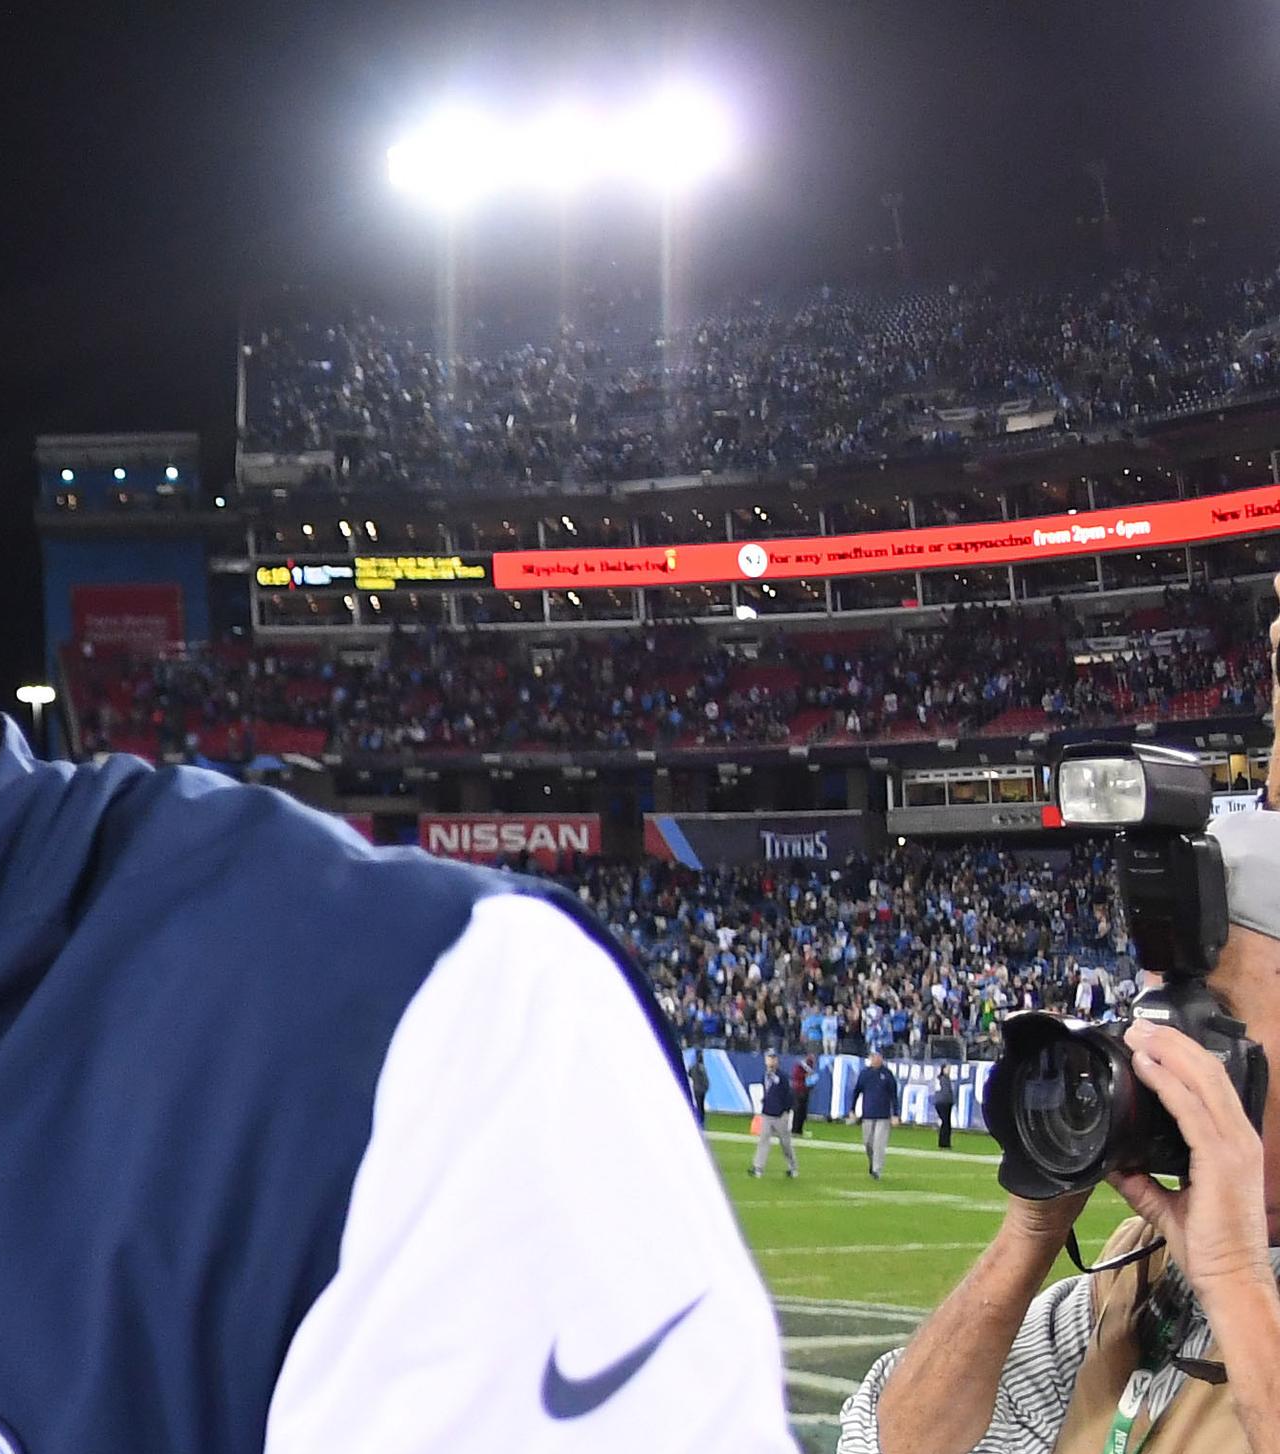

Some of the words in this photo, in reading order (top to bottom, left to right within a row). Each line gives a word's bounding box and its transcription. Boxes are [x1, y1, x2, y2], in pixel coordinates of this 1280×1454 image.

[1033, 528, 1070, 547] from
[1071, 524, 1106, 544] 2pm
[1115, 519, 1151, 539] 6pm
[769, 553, 792, 564] for
[795, 554, 822, 565] any
[827, 546, 889, 562] medium
[891, 544, 924, 556] latte
[928, 544, 944, 554] or
[947, 533, 1032, 553] cappuccino
[429, 823, 589, 853] NISSAN
